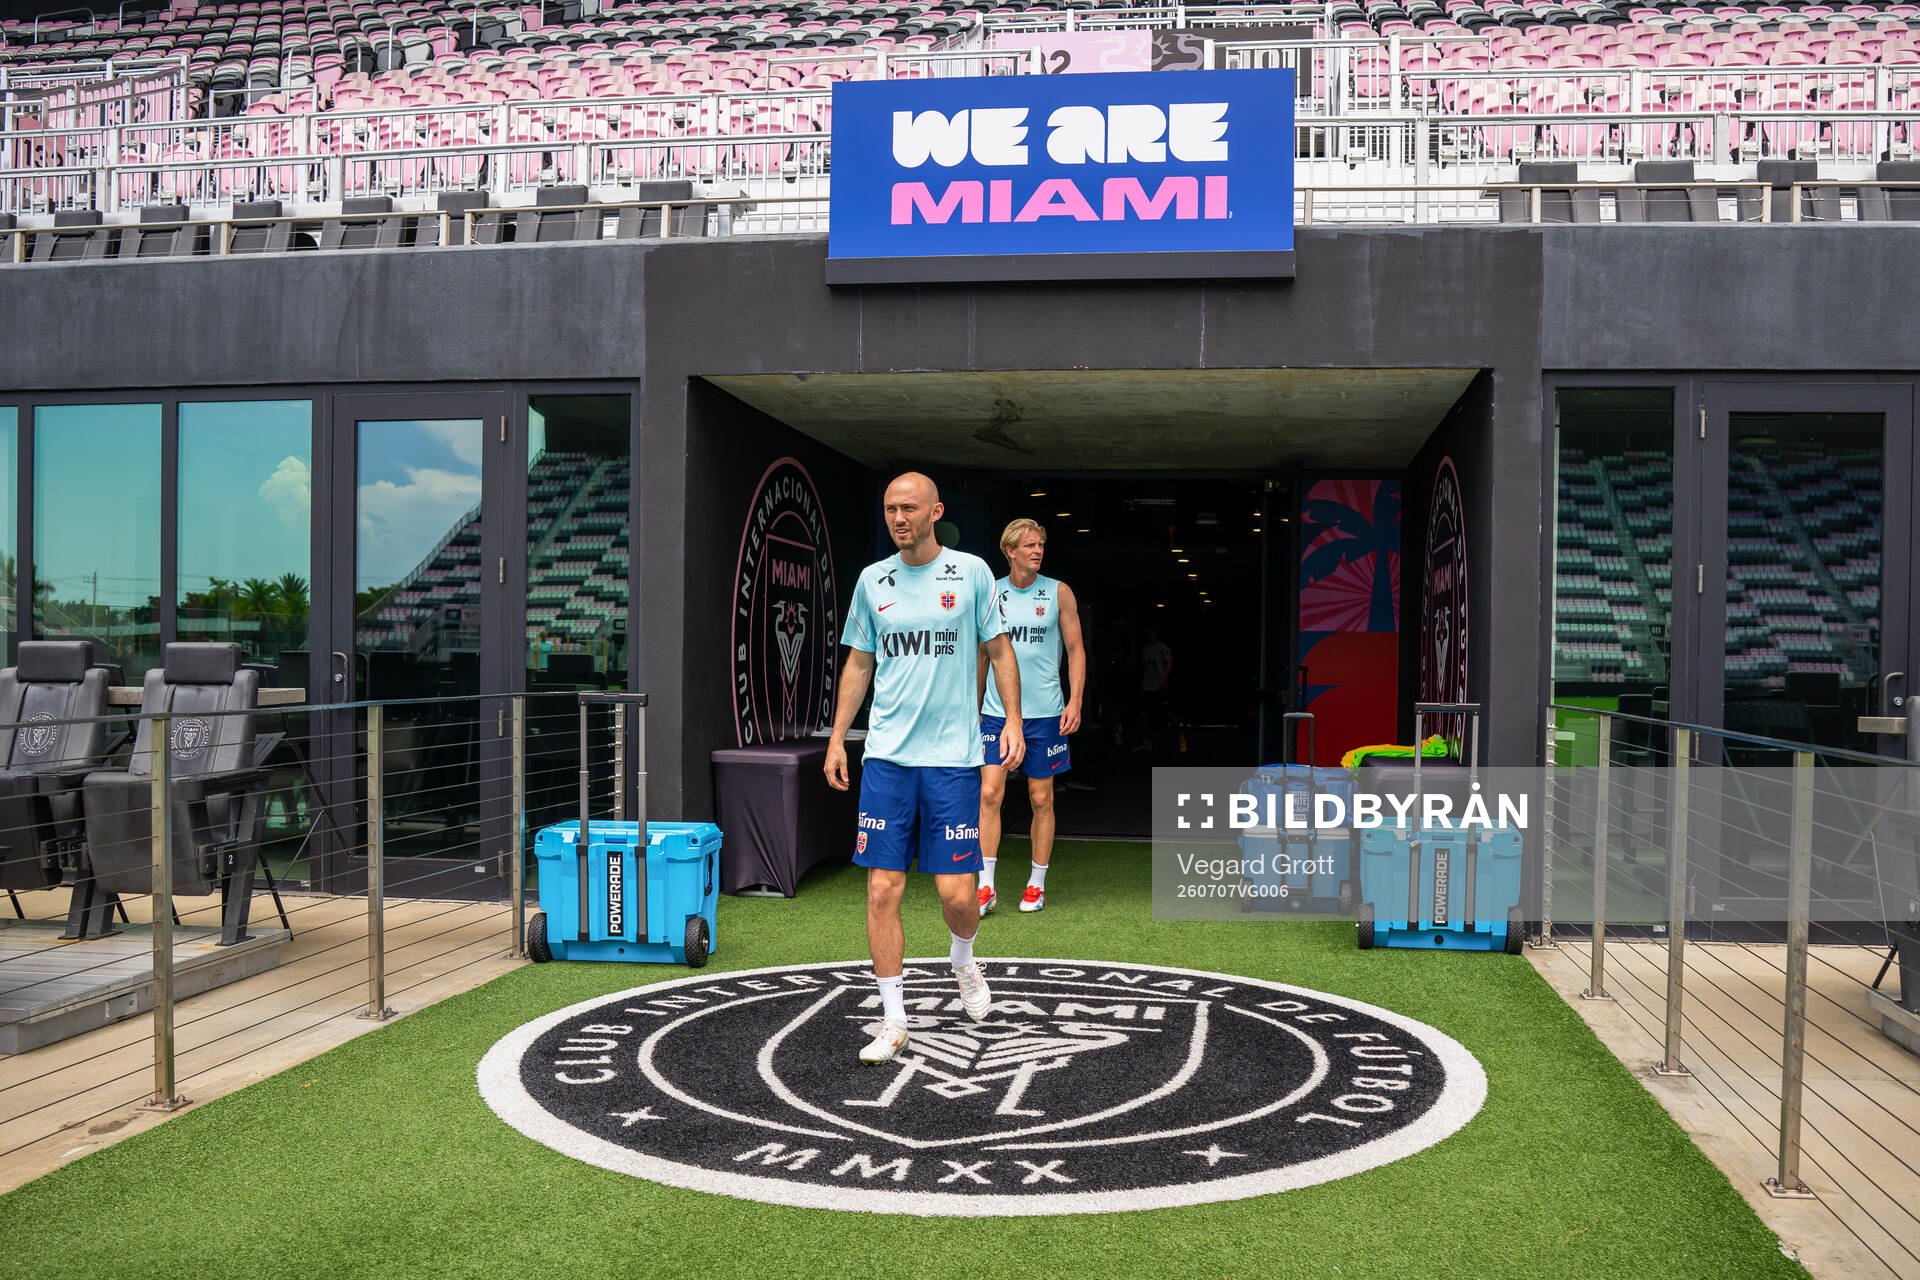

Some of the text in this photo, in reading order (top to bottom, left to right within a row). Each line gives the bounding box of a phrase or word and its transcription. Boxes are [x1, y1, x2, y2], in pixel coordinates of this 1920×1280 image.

[892, 102, 1229, 168] WE ARE
[890, 175, 1228, 225] MIAMI
[739, 478, 823, 618] INTERNACIONAL
[772, 558, 811, 592] MIAMI
[820, 551, 831, 594] DE
[882, 629, 930, 658] KIWI
[934, 628, 958, 642] mini
[1008, 626, 1027, 642] WI
[1030, 626, 1048, 634] mini
[1030, 635, 1044, 644] pris
[934, 643, 955, 657] pris
[737, 642, 754, 744] CLUB
[228, 854, 234, 865] 2
[554, 966, 1422, 1129] CLUB INTERNAIONAL DE FÚTBOL
[732, 1140, 1079, 1186] MMXX
